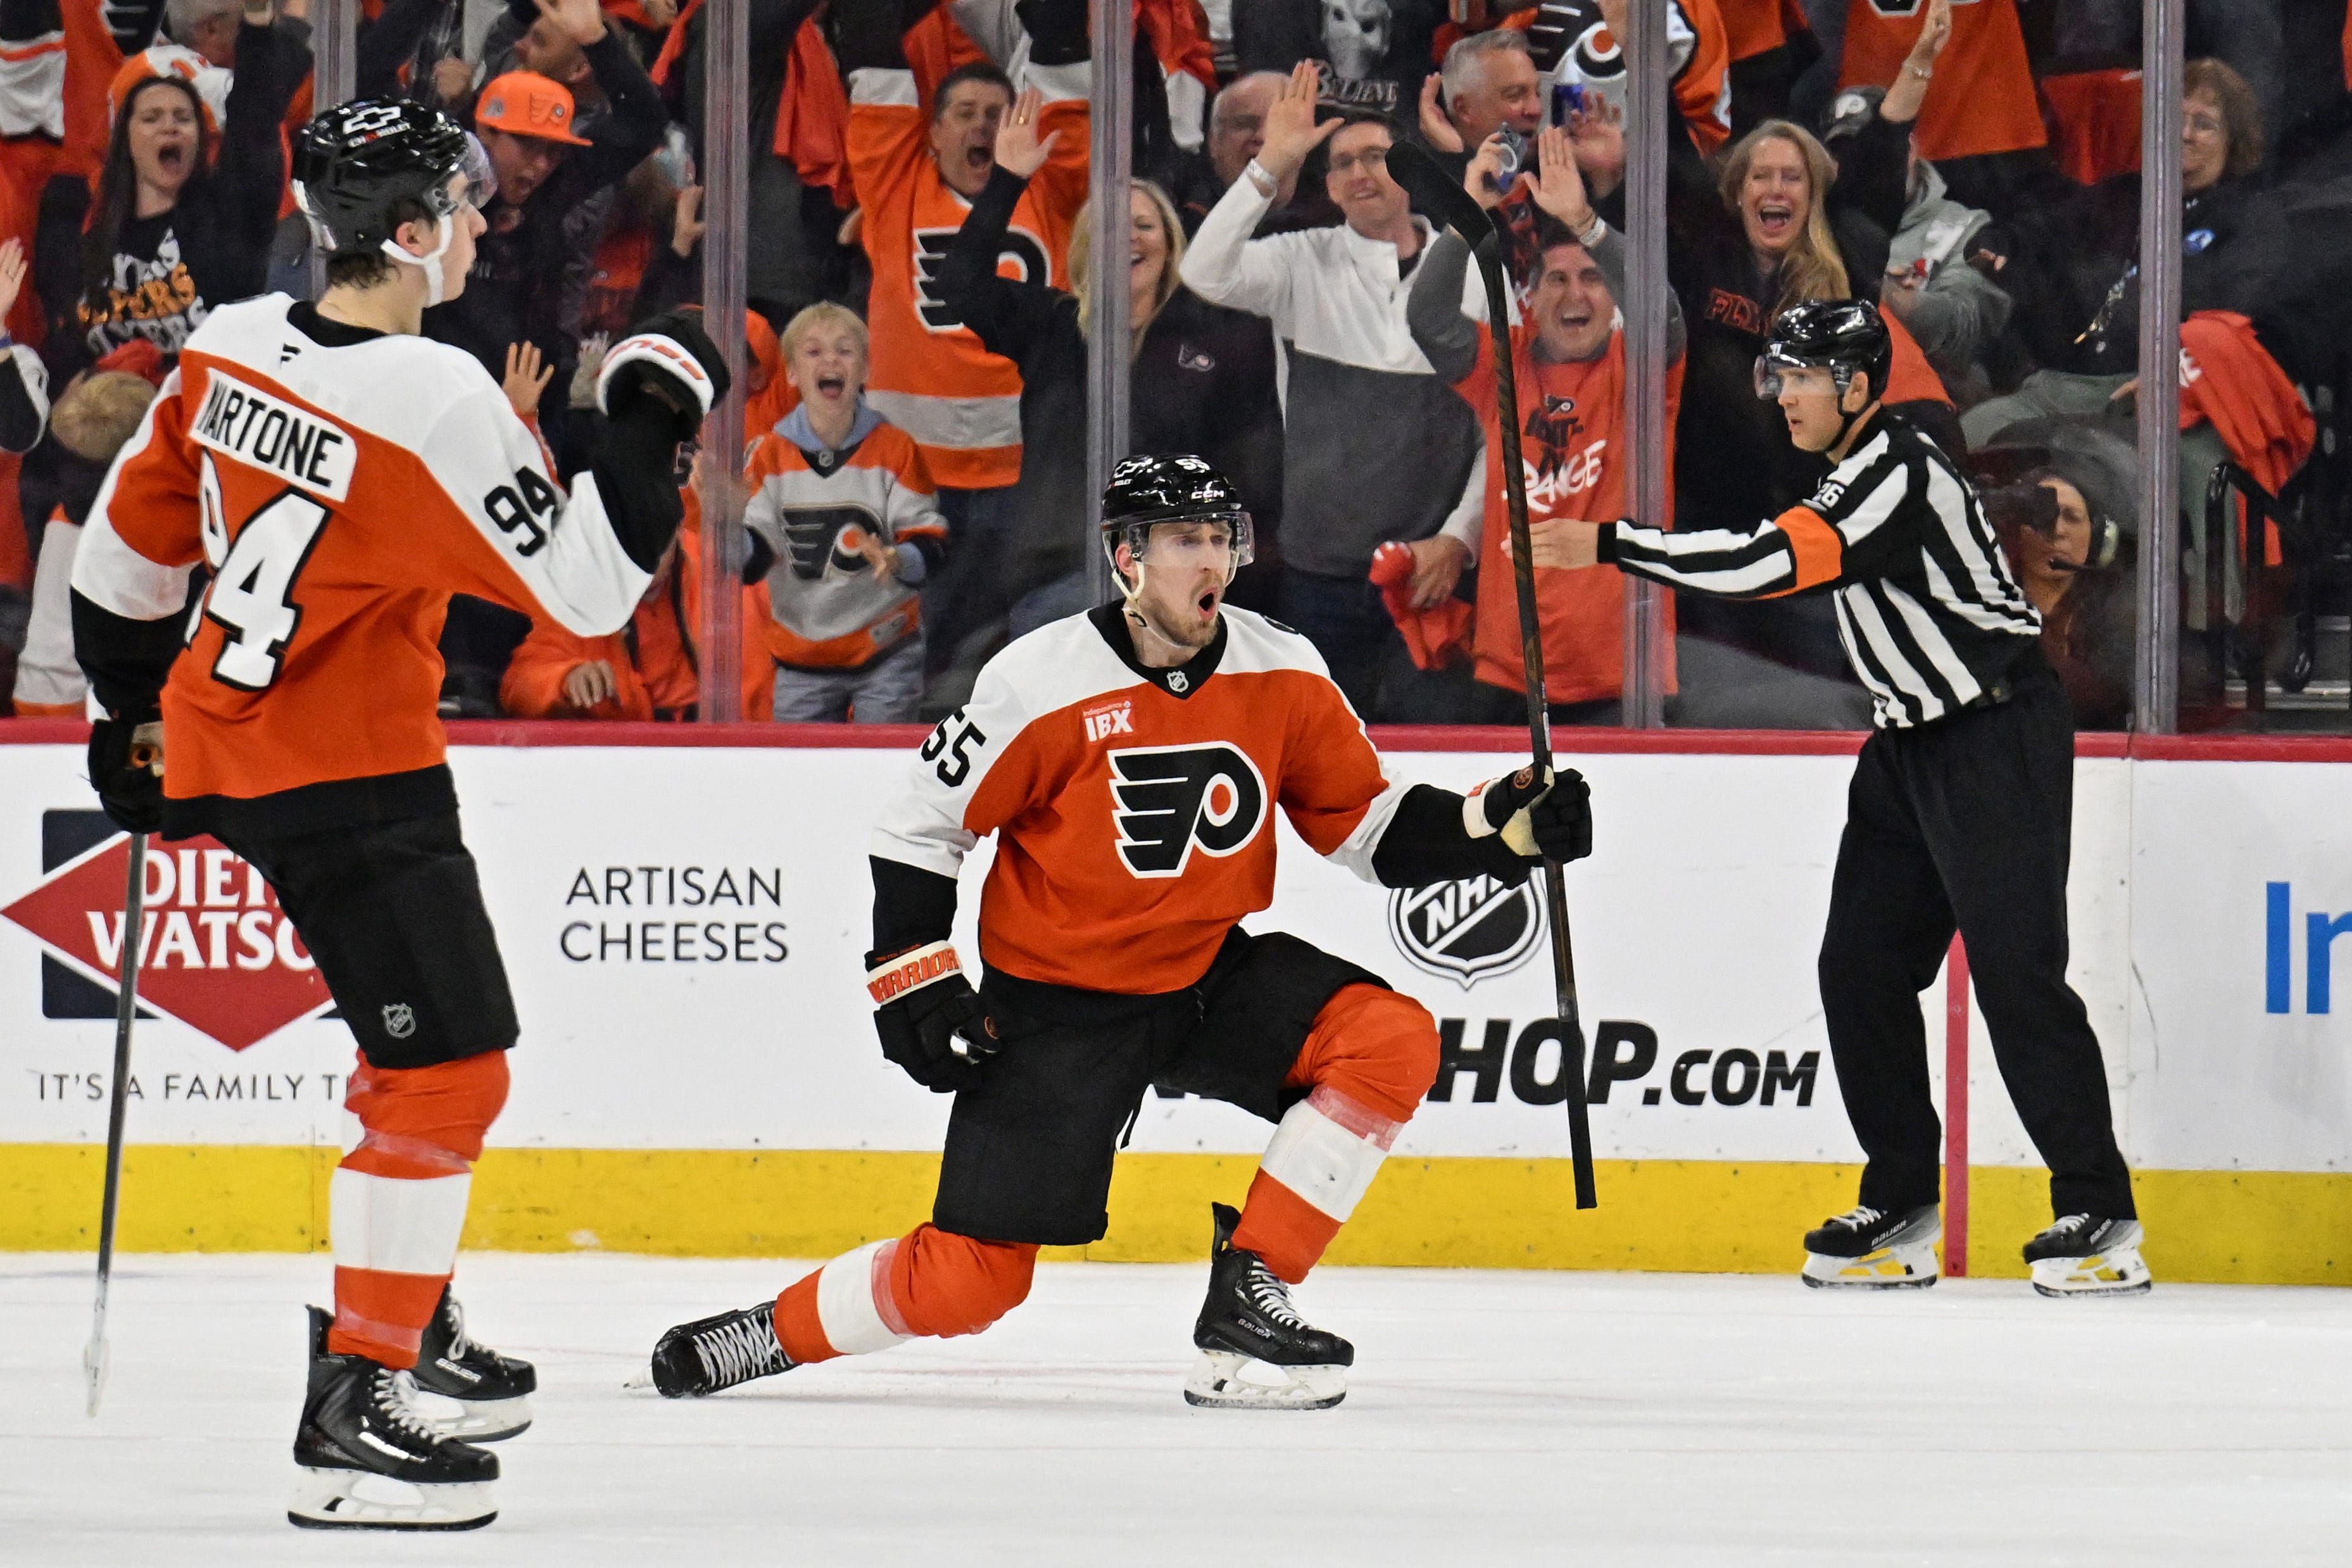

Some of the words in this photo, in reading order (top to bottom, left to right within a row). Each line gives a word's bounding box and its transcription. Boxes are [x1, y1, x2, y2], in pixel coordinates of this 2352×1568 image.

[484, 465, 564, 557] 94
[1191, 490, 1224, 499] CCM
[1085, 708, 1133, 742] IBX
[921, 708, 987, 787] 55
[141, 849, 280, 907] DIET
[566, 867, 781, 906] ARTISAN
[560, 920, 789, 962] CHEESES
[40, 1074, 104, 1100] IT'S
[127, 1074, 145, 1100] A
[165, 1074, 305, 1100] FAMILY
